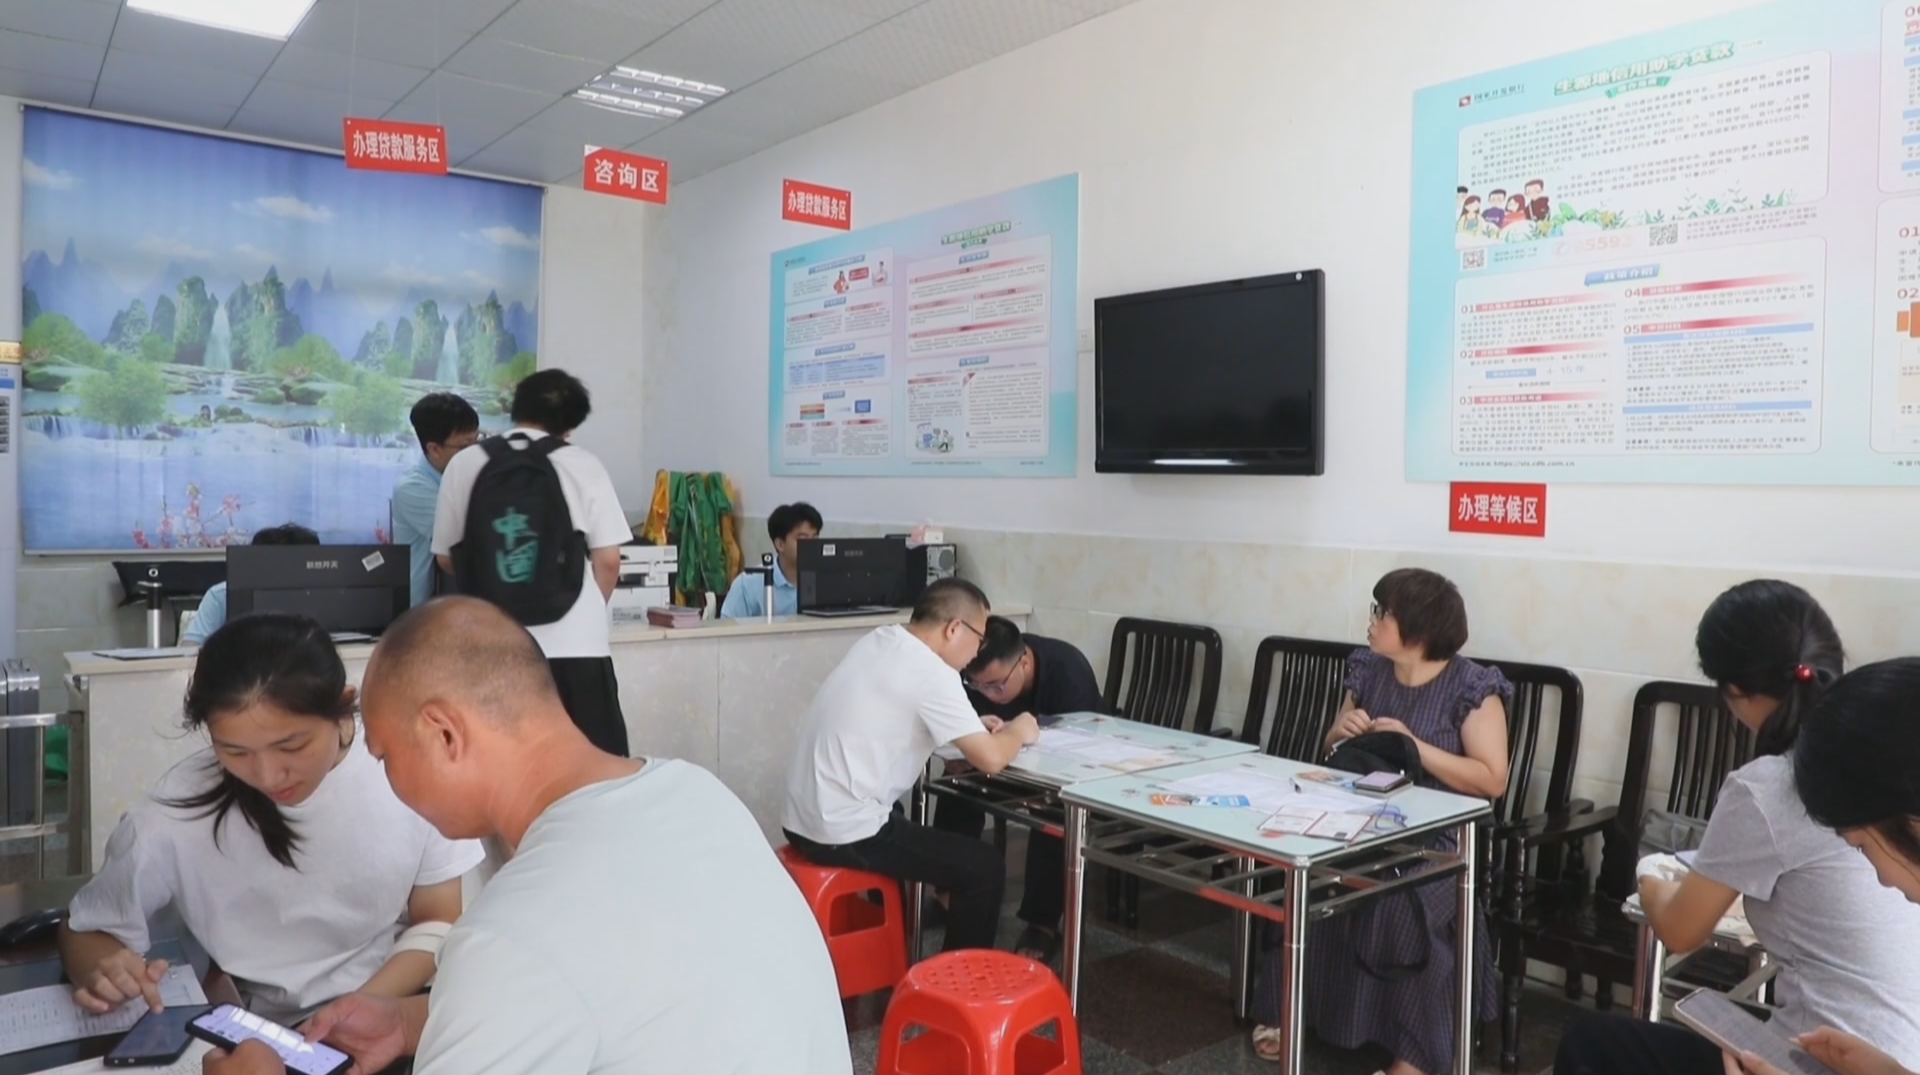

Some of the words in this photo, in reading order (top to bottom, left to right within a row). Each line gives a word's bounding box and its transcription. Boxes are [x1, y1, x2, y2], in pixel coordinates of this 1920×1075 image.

[1555, 41, 1735, 96] 生源地信用助学贷款
[352, 128, 441, 164] 办理贷款服务区
[593, 158, 660, 193] 咨询区
[787, 188, 848, 222] 办理贷款服务区
[1603, 265, 1656, 282] 政策介绍
[1624, 287, 1641, 298] 04
[1461, 304, 1476, 314] 01
[1623, 324, 1641, 335] 05
[1460, 350, 1475, 359] 02
[1459, 396, 1474, 405] 03
[1457, 493, 1539, 525] 办理等候区
